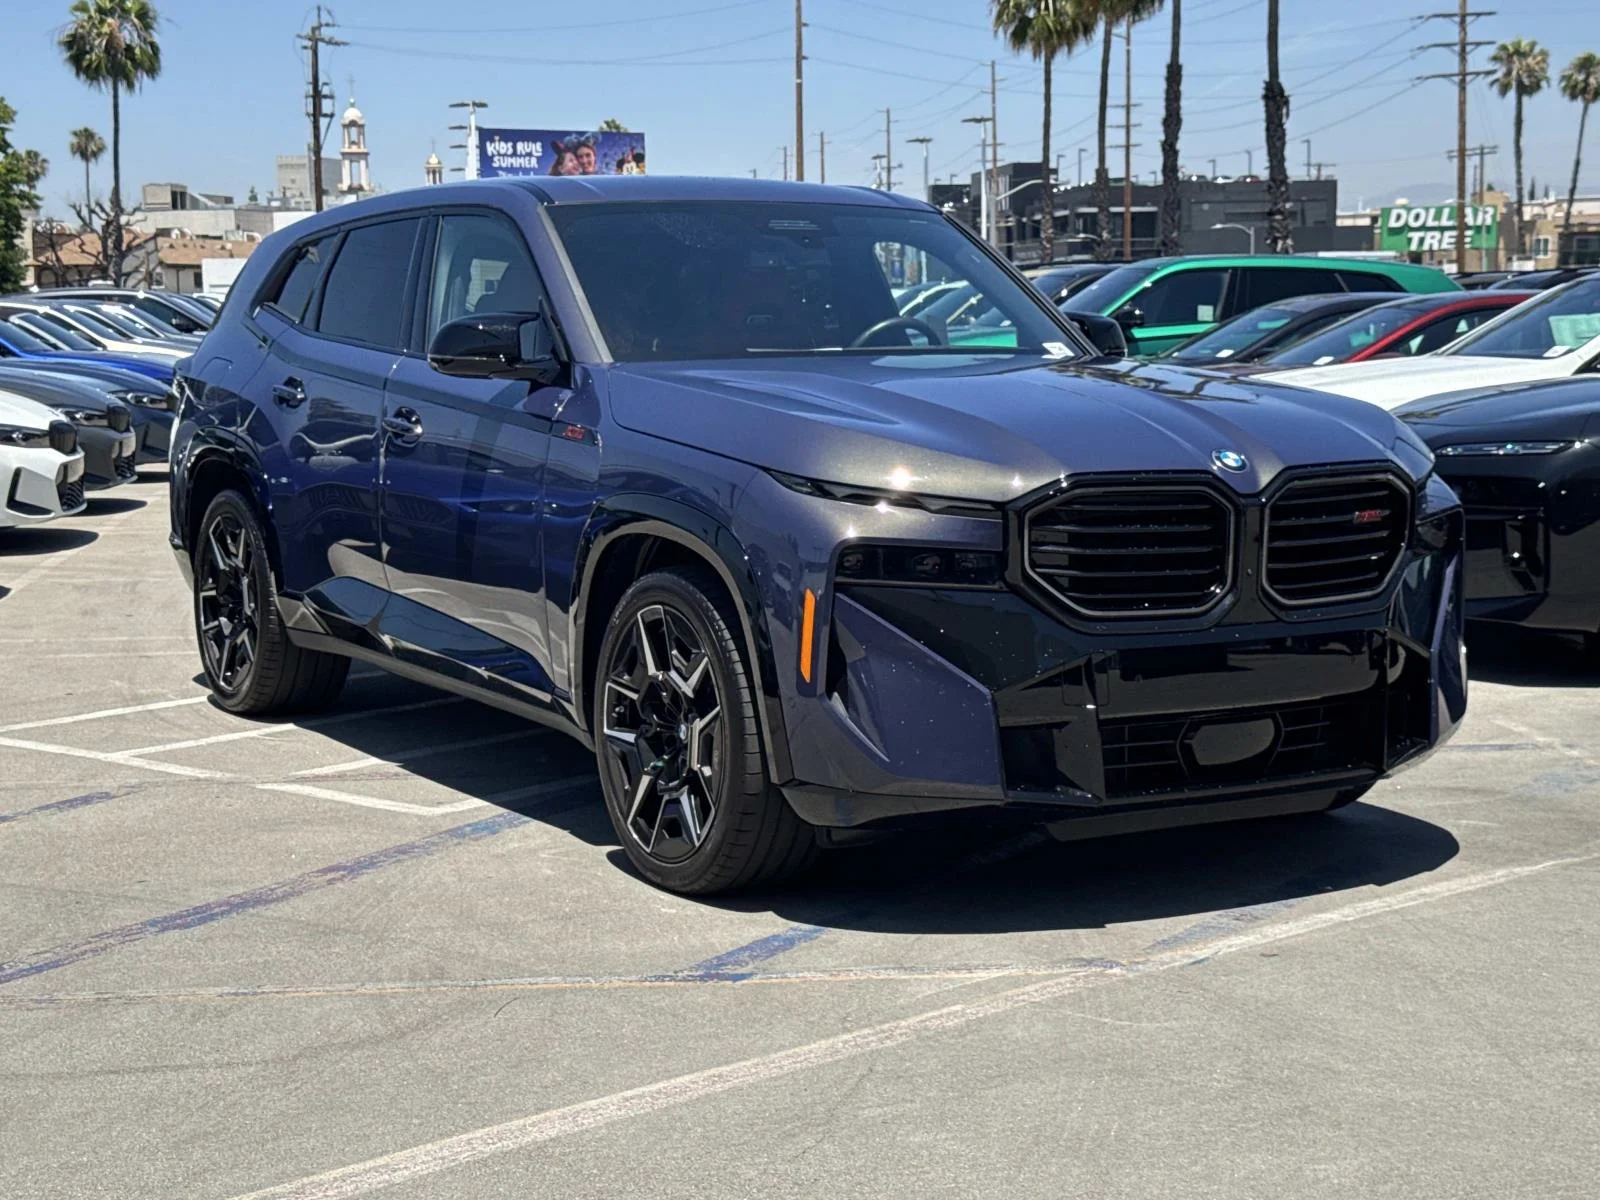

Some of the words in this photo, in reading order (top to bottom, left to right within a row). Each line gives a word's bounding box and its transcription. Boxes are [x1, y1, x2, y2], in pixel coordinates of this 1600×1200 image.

[516, 140, 543, 156] RULE
[491, 156, 539, 169] SUMMER
[1387, 207, 1495, 228] DOLLAR
[1407, 230, 1474, 251] TREE
